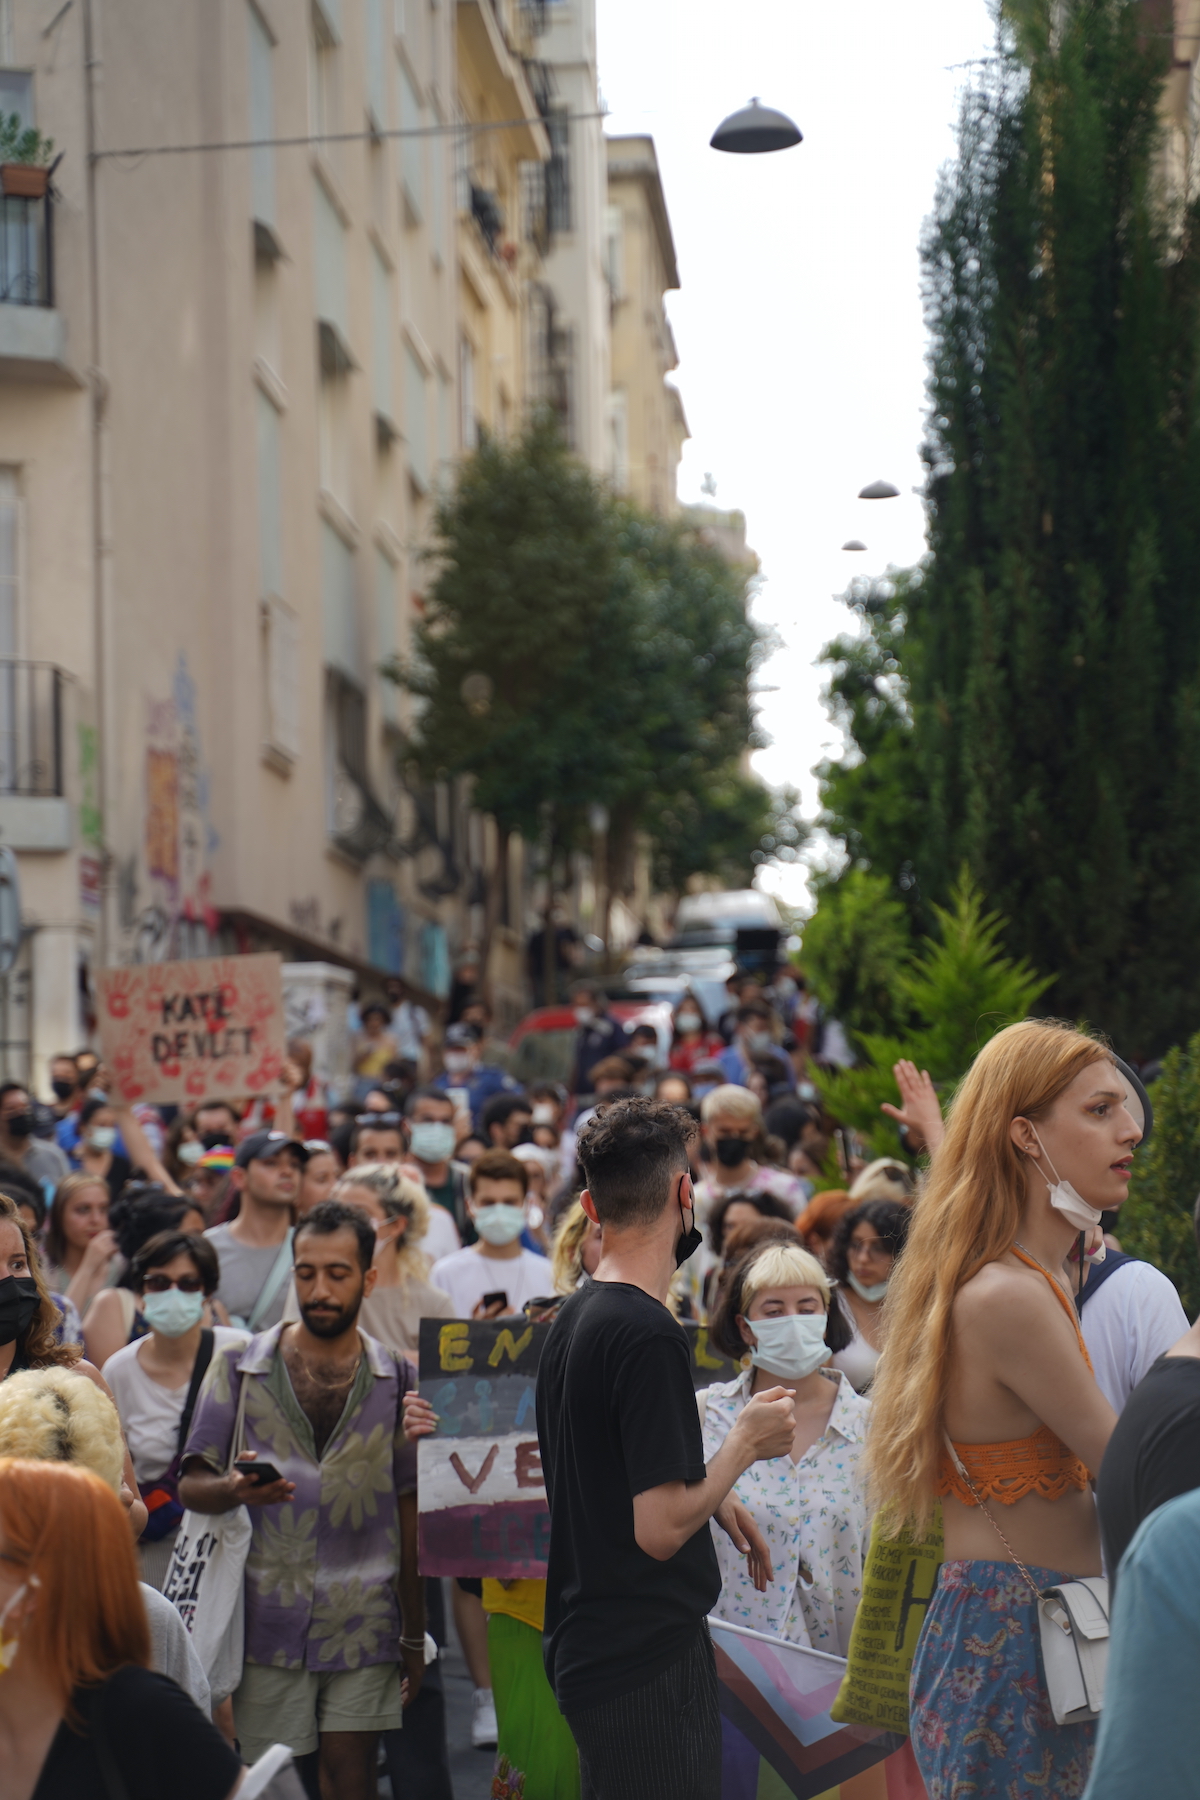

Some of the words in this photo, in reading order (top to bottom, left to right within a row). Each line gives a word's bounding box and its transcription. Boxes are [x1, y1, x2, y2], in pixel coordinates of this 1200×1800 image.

[152, 1026, 257, 1063] DEVLET
[438, 1322, 534, 1372] EN
[448, 1440, 545, 1494] VE
[874, 1545, 904, 1564] DEMEK
[871, 1562, 902, 1583] HAKKIM
[859, 1618, 881, 1631] SORUN
[883, 1619, 897, 1632] YOK
[846, 1689, 872, 1710] DEMEK
[843, 1705, 873, 1724] HAKKIM
